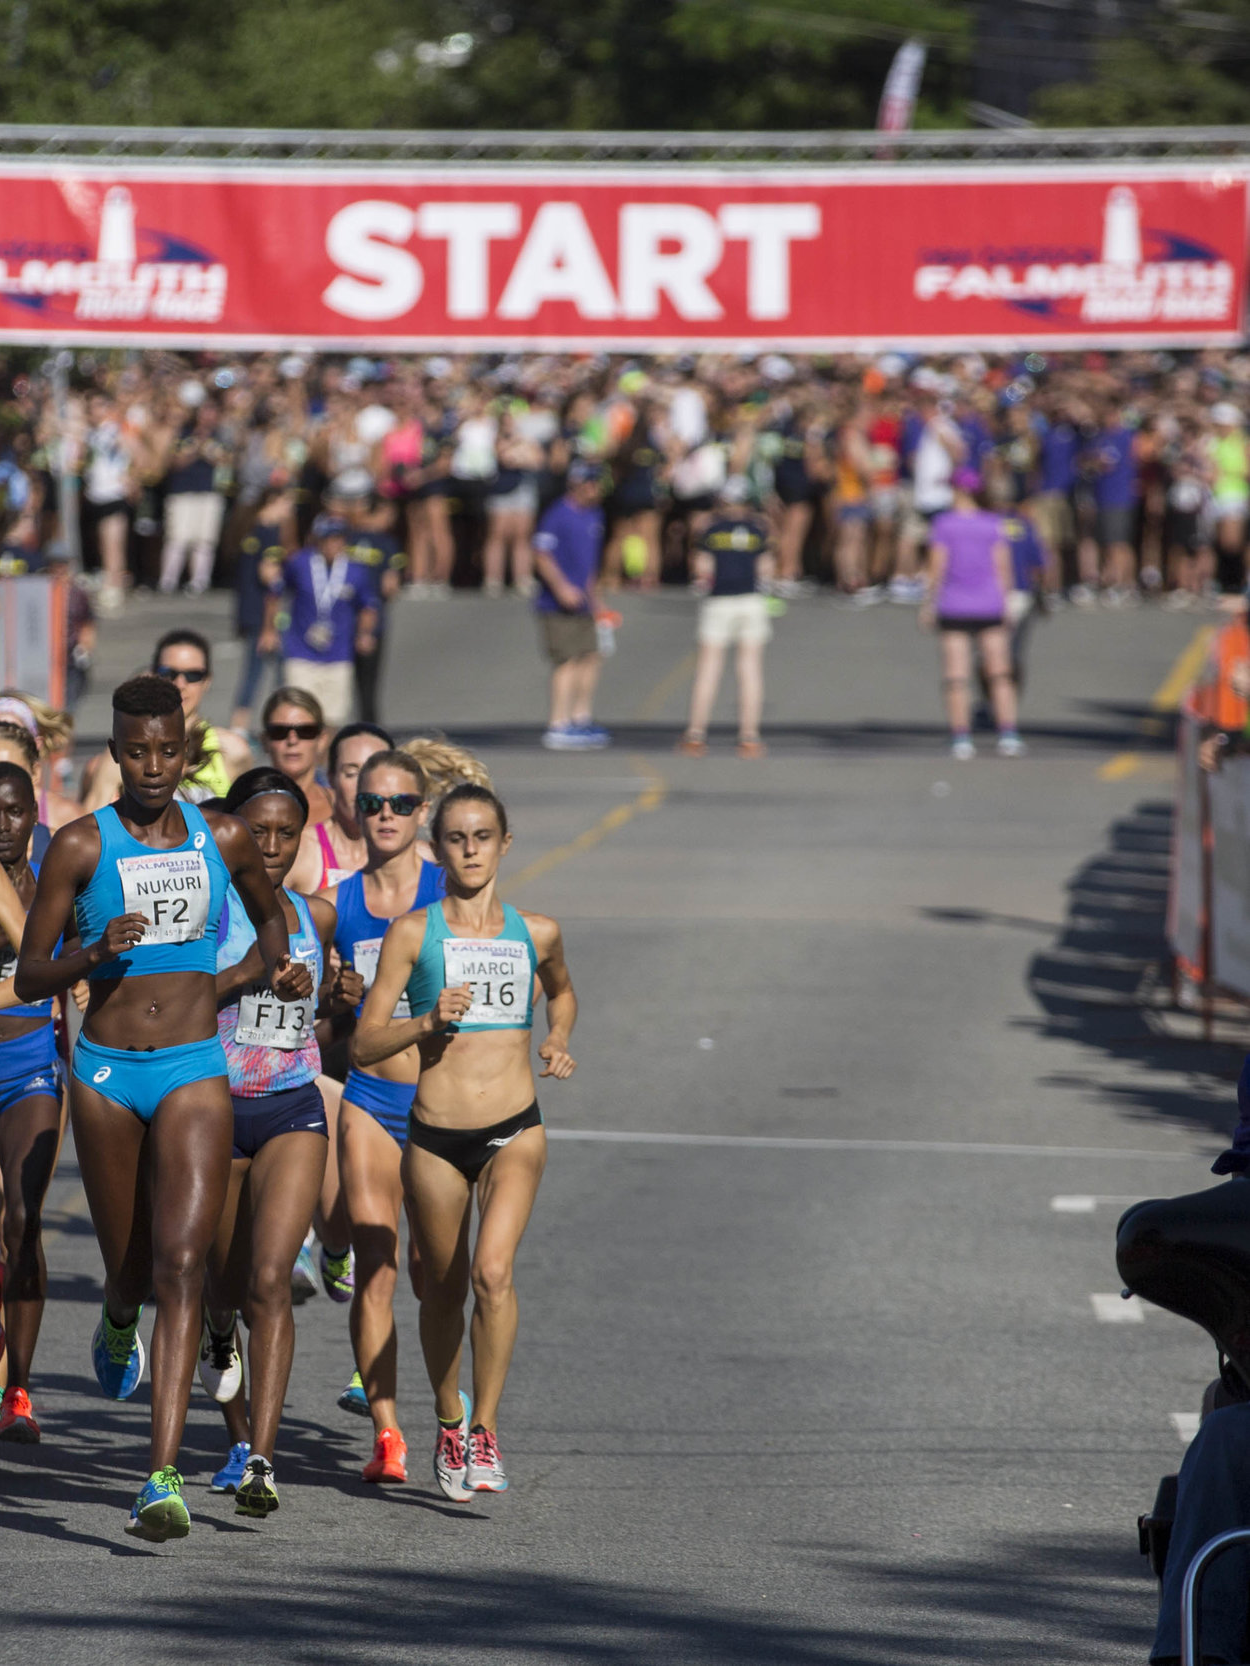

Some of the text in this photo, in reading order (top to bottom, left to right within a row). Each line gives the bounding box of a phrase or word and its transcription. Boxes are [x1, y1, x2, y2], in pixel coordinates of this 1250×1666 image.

[321, 199, 821, 322] START
[136, 875, 202, 896] NUKURI
[153, 898, 190, 926] F2
[462, 961, 514, 975] MARCI
[255, 1003, 306, 1031] F13
